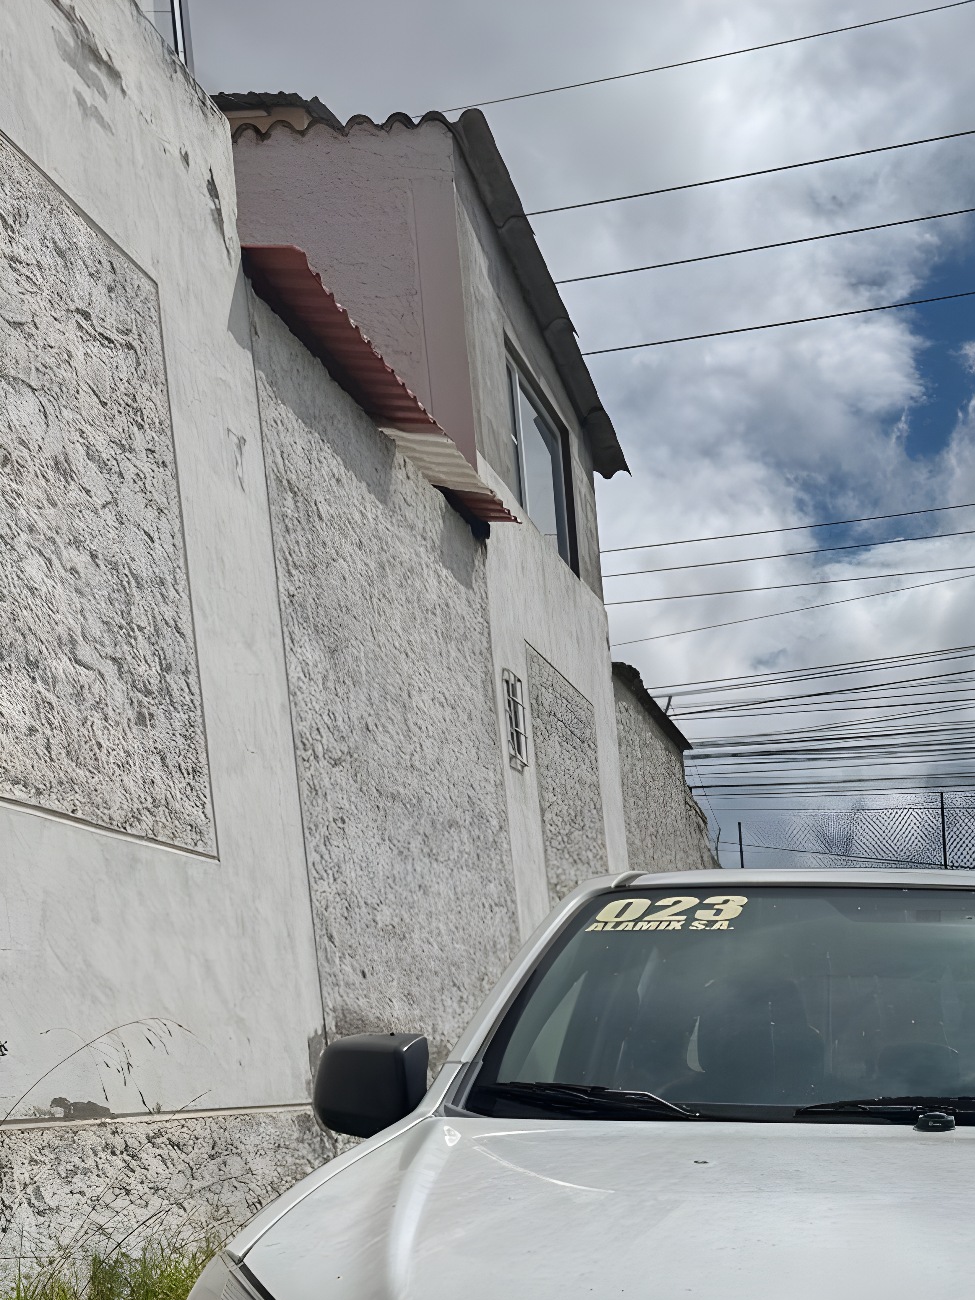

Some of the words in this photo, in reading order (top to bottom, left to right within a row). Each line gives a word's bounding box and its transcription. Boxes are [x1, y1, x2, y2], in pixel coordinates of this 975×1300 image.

[595, 895, 748, 922] 023
[585, 920, 686, 932] ALAMIX
[689, 920, 735, 930] S.A.
